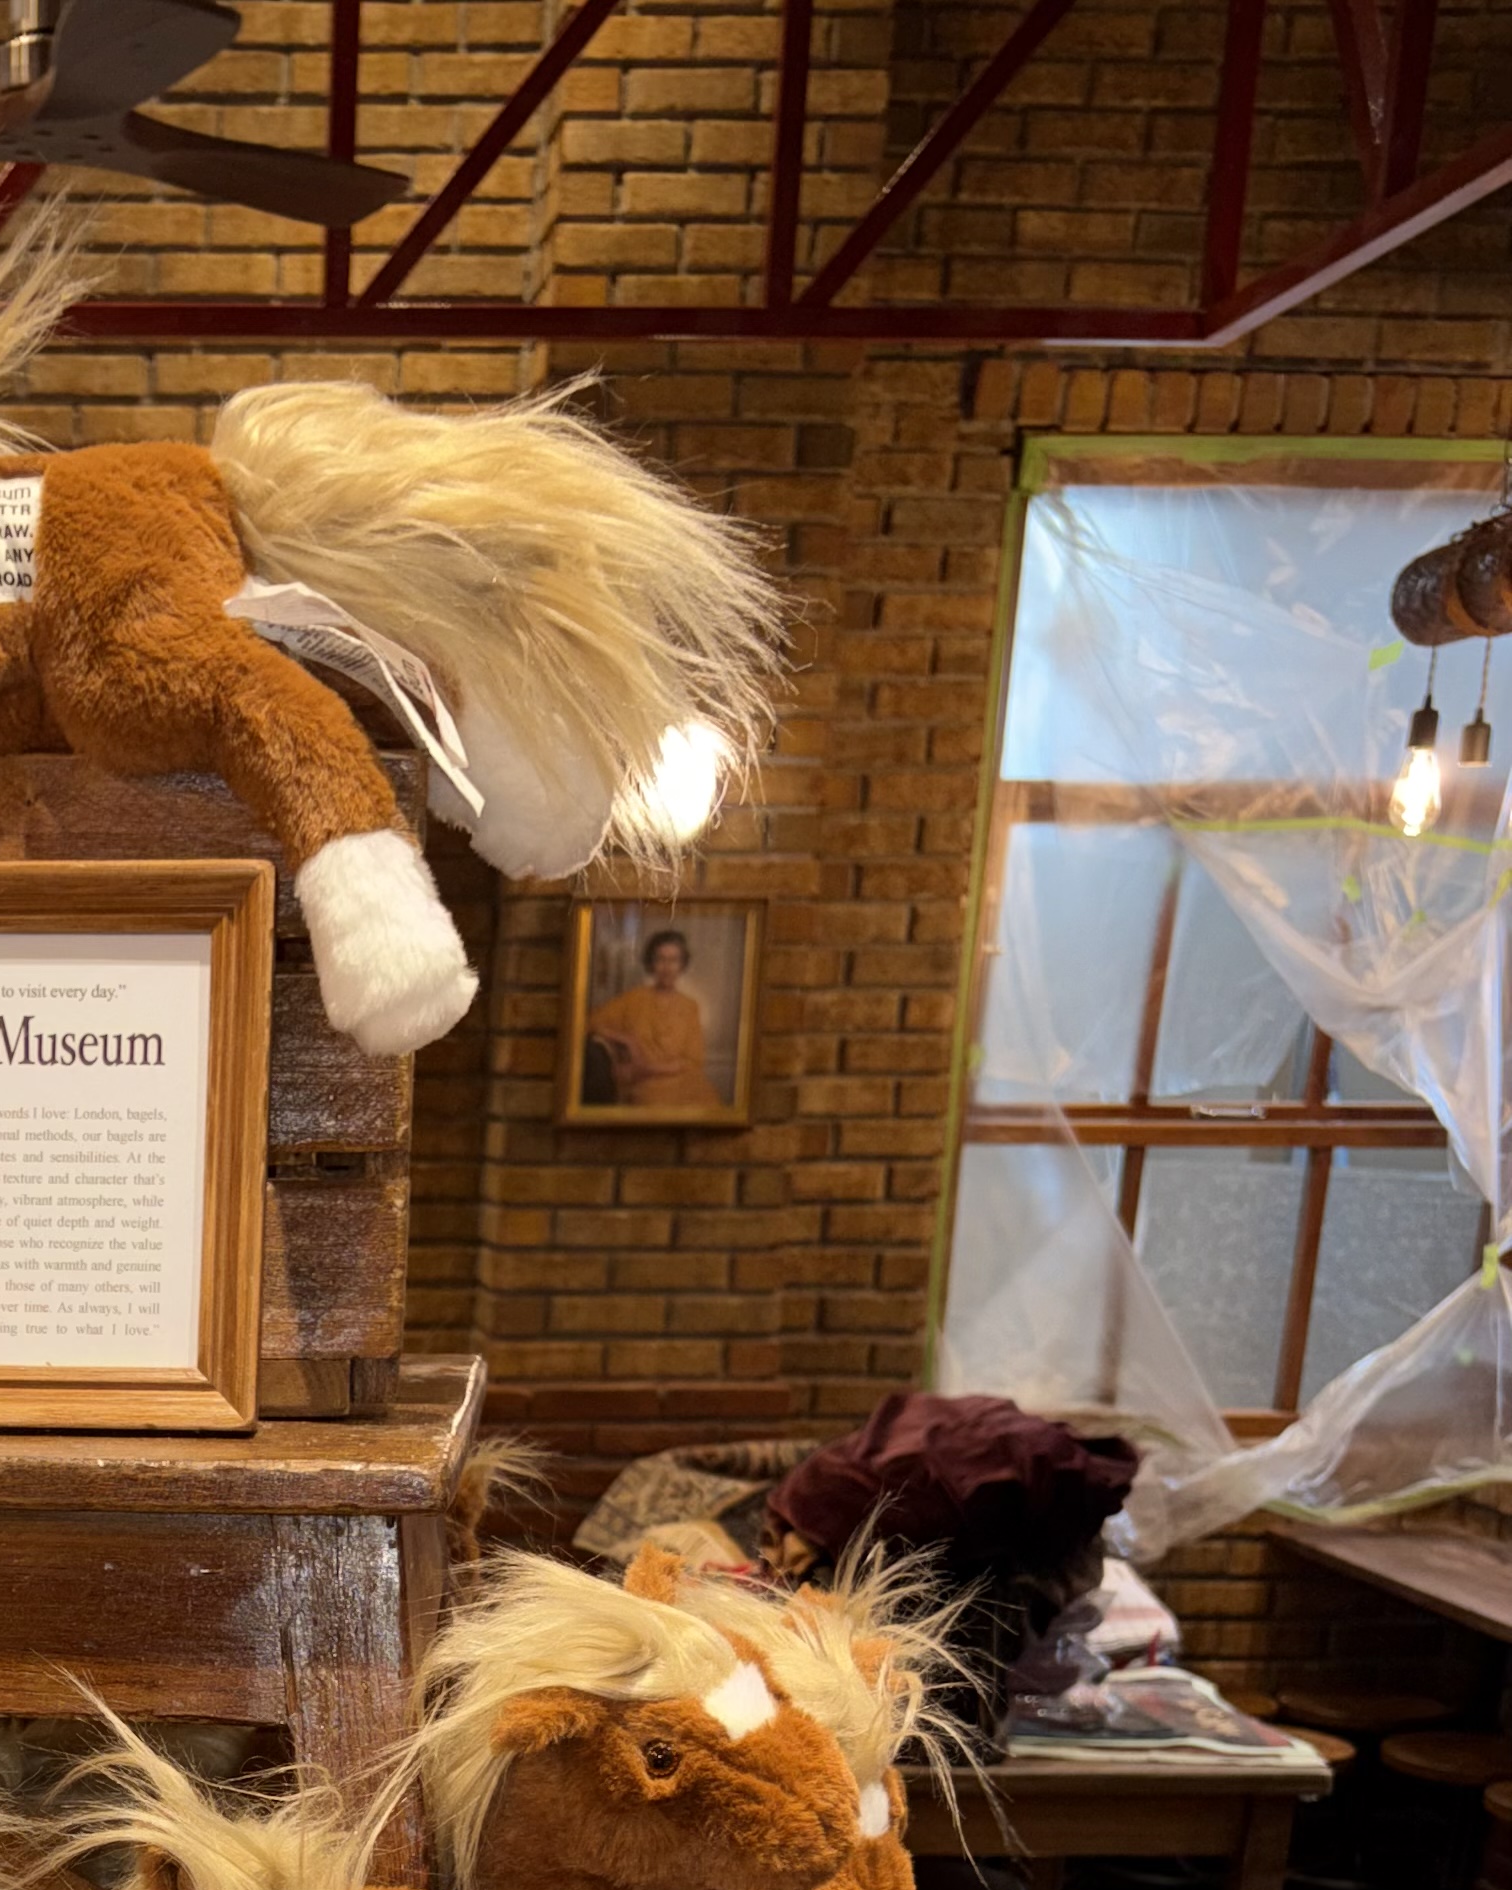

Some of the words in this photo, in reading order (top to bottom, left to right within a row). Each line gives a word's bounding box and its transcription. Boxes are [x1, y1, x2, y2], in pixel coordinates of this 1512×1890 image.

[5, 548, 34, 563] ANY
[1, 986, 15, 998] to
[18, 984, 48, 998] visit
[50, 988, 88, 1002] every
[82, 1133, 102, 1141] our
[107, 1129, 143, 1144] bagels
[148, 1133, 166, 1142] are
[22, 1151, 44, 1163] and
[126, 1152, 142, 1163] At
[148, 1152, 166, 1164] the
[3, 1174, 42, 1184] texture
[48, 1173, 69, 1184] and
[75, 1173, 128, 1185] character
[14, 1194, 52, 1205] vibrant
[133, 1195, 163, 1207] while
[6, 1214, 20, 1227] of
[23, 1218, 52, 1230] quiet
[57, 1216, 89, 1231] depth
[94, 1216, 115, 1229] and
[19, 1237, 44, 1248] who
[48, 1238, 104, 1252] recognize
[109, 1238, 127, 1250] the
[131, 1238, 163, 1250] value
[14, 1258, 39, 1270] with
[44, 1258, 87, 1270] warmth
[91, 1259, 112, 1271] and
[116, 1263, 161, 1275] genuine
